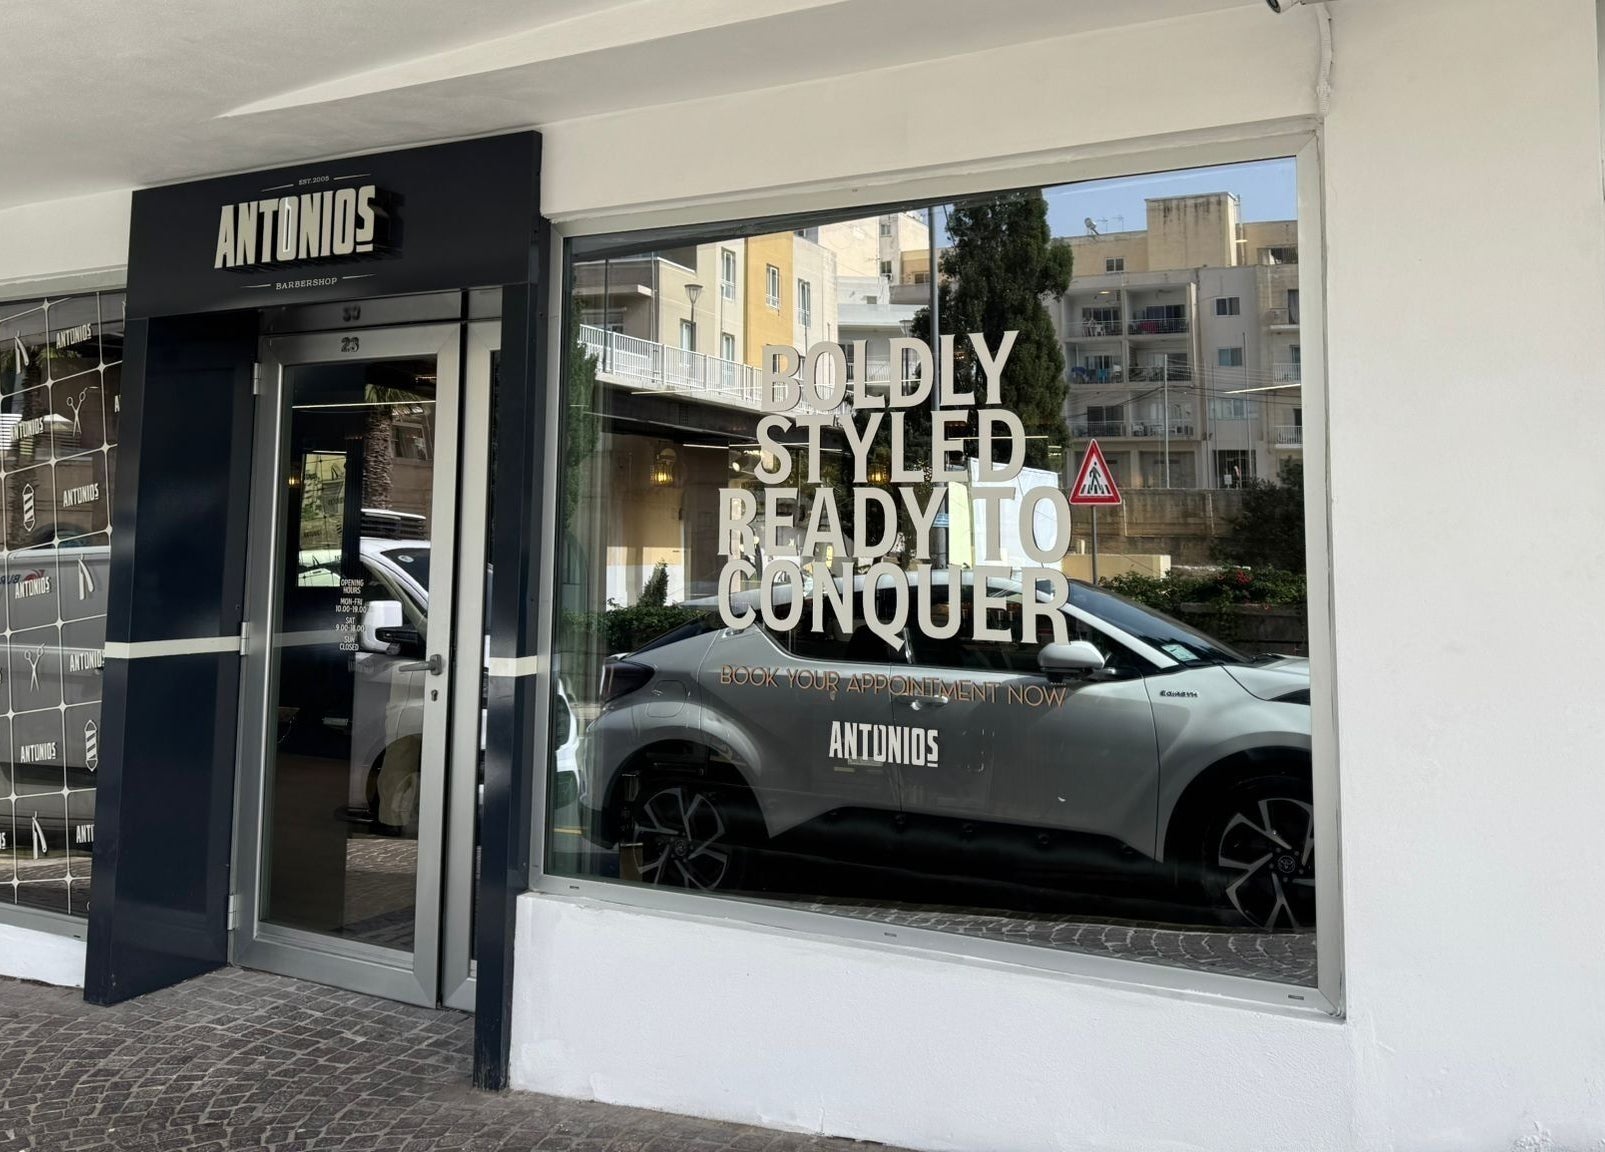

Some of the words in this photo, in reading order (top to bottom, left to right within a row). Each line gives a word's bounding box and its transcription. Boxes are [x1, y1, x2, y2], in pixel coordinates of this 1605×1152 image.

[213, 184, 376, 269] ANTONIOS
[275, 276, 338, 291] BARBERSHOP
[55, 322, 92, 350] ANTONIOS
[340, 336, 360, 353] 23
[760, 329, 1020, 413] BOLDLY
[753, 408, 1027, 485] STYLED
[62, 482, 99, 508] ANTONIOS
[717, 486, 950, 561] READY
[971, 485, 1072, 564] TO
[14, 576, 51, 599] ANTONIOS
[340, 578, 365, 587] OPENING
[343, 586, 361, 595] HOURS
[340, 597, 363, 606] MON-FRI
[717, 559, 1072, 653] CONQUER
[345, 616, 356, 625] SAT
[339, 643, 360, 652] CLOSED
[344, 635, 356, 644] SUN
[720, 664, 780, 689] BOOK
[785, 666, 841, 692] YOUR
[846, 672, 1001, 704] APPOINTMENT
[1008, 684, 1067, 709] NOW
[20, 742, 57, 764] ANTONIOS
[828, 720, 940, 768] ANTONIOS
